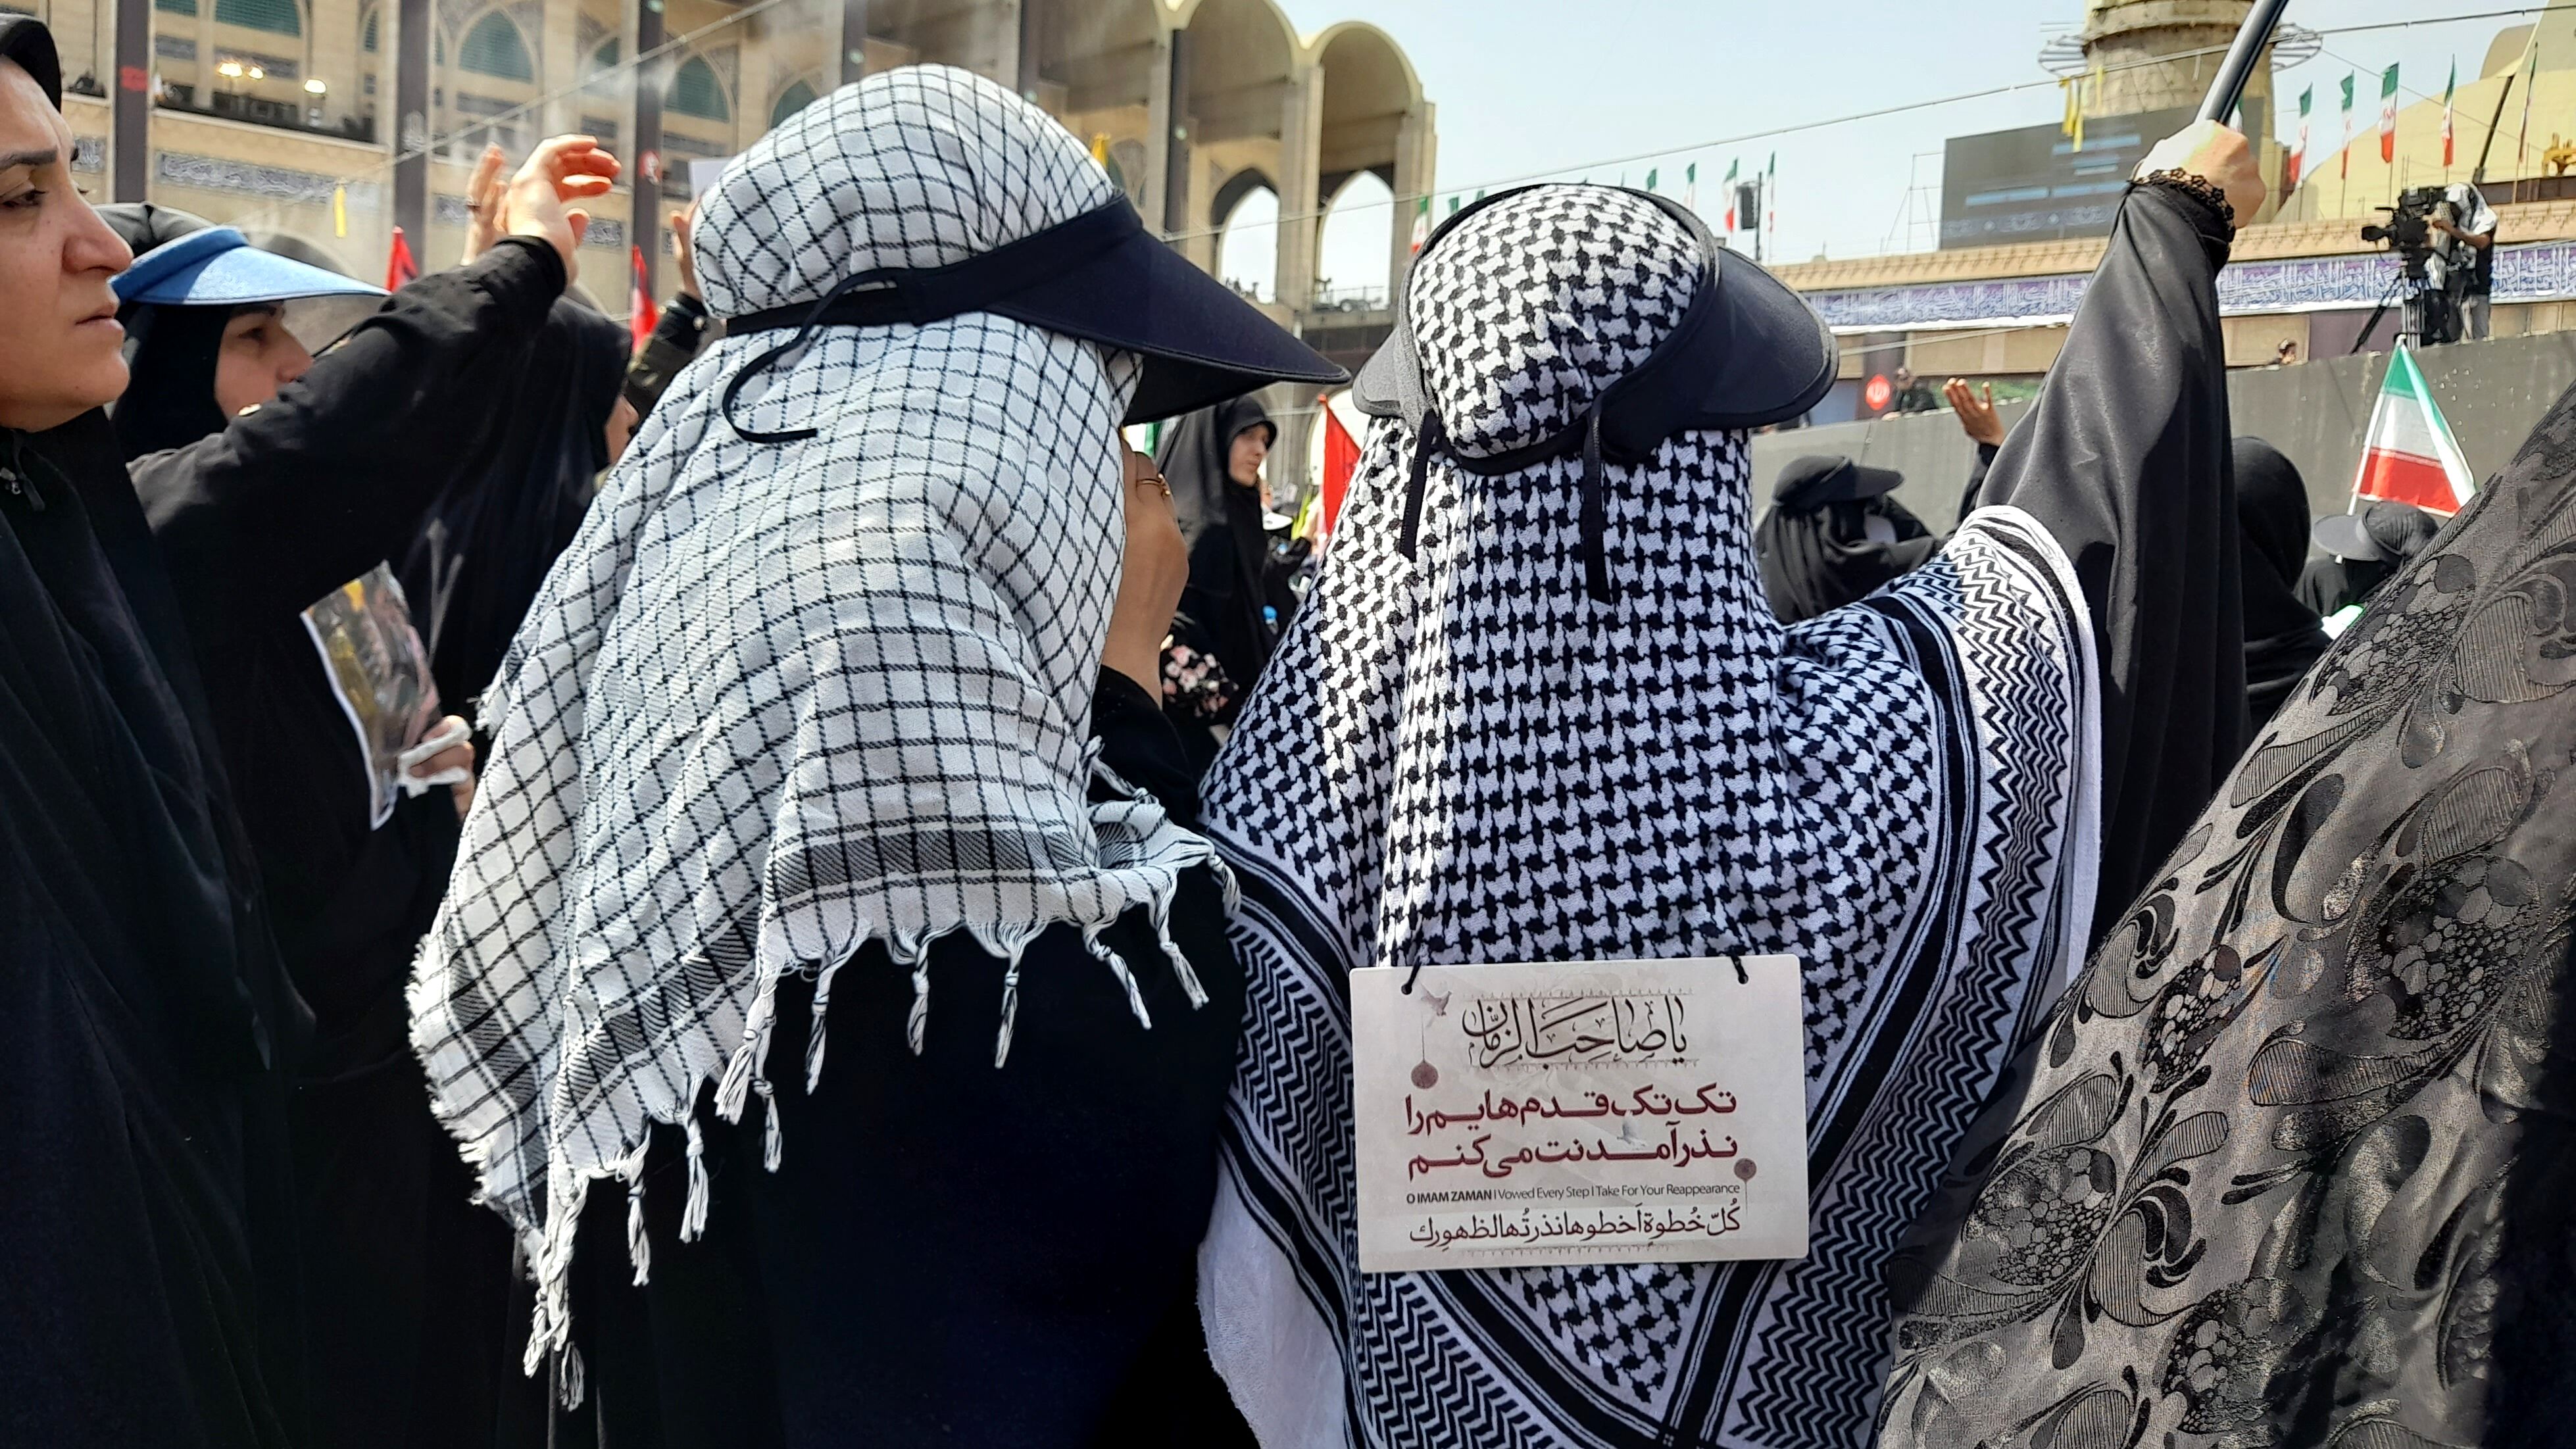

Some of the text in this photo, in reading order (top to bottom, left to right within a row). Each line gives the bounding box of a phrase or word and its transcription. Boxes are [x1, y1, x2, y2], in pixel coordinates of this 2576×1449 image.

[1404, 1094, 1424, 1135] را
[1611, 1083, 1672, 1116] تک
[1673, 1082, 1737, 1116] تک
[1534, 1120, 1681, 1162] آمدنت
[1673, 1128, 1738, 1167] نذر
[1406, 1192, 1416, 1204] O
[1418, 1191, 1449, 1203] IMAM
[1451, 1189, 1492, 1202] ZAMAN
[1498, 1188, 1535, 1199] Vowed
[1537, 1187, 1564, 1200] Every
[1566, 1186, 1590, 1199] Step
[1591, 1186, 1594, 1196] I
[1595, 1185, 1620, 1196] Take
[1622, 1185, 1638, 1196] For
[1640, 1184, 1665, 1196] Your
[1666, 1183, 1741, 1197] Reappearance
